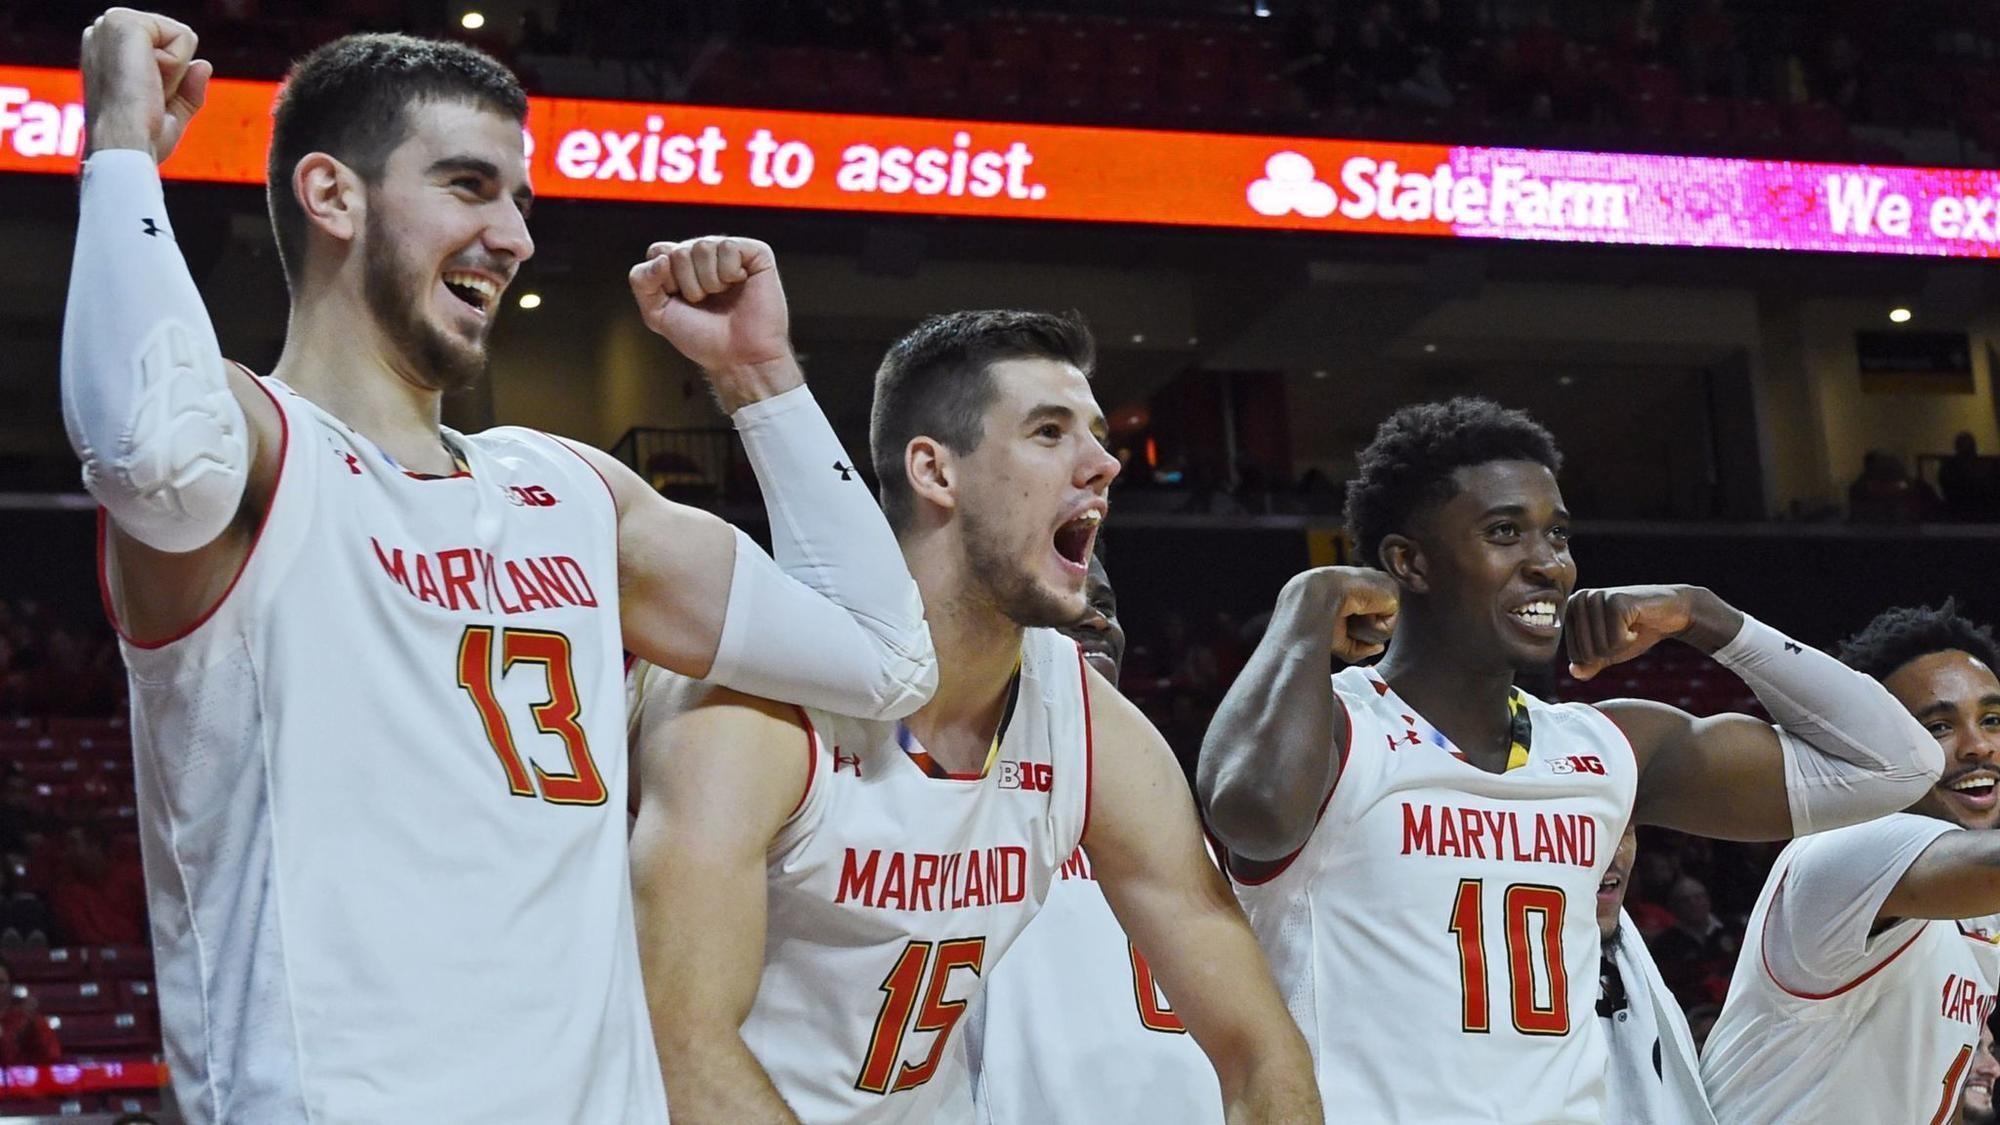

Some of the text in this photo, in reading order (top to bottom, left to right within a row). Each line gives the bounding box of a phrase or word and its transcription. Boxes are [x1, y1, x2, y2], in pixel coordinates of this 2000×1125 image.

[0, 86, 85, 158] Far
[555, 115, 727, 185] exist
[746, 129, 815, 189] to
[836, 131, 1046, 200] assist.
[1826, 173, 2000, 243] We ex
[370, 536, 598, 615] MARYLAND
[457, 624, 608, 806] 13
[1401, 802, 1596, 868] MARYLAND
[834, 846, 1027, 912] MARYLAND
[1448, 878, 1570, 1036] 10
[854, 936, 986, 1095] 15
